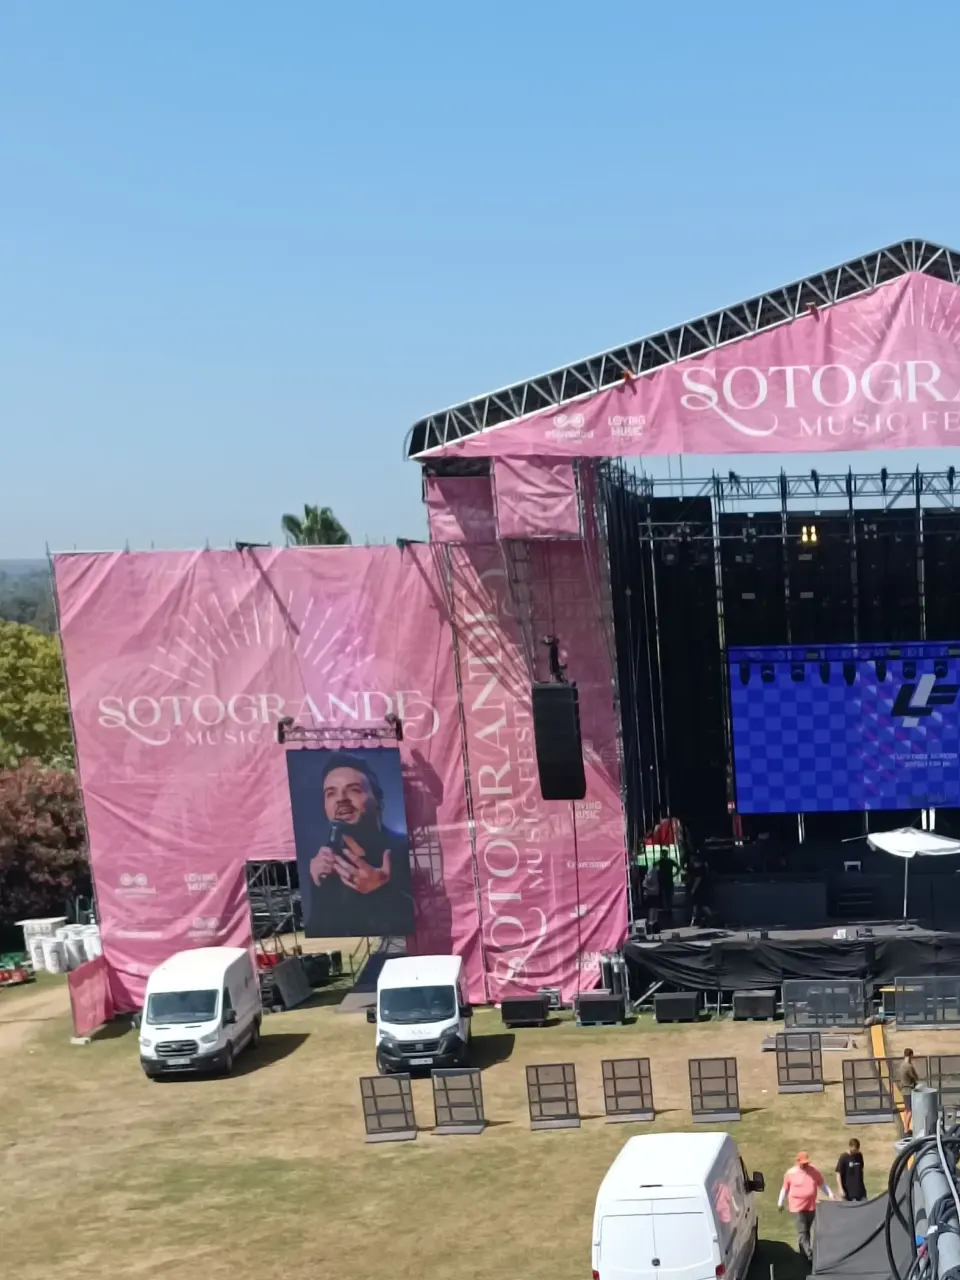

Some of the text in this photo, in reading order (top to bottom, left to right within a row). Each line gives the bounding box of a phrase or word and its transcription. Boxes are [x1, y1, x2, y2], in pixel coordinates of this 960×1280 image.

[799, 411, 901, 437] MUSIC
[98, 690, 440, 746] SOTOGRANDE
[184, 729, 261, 747] MUSIC
